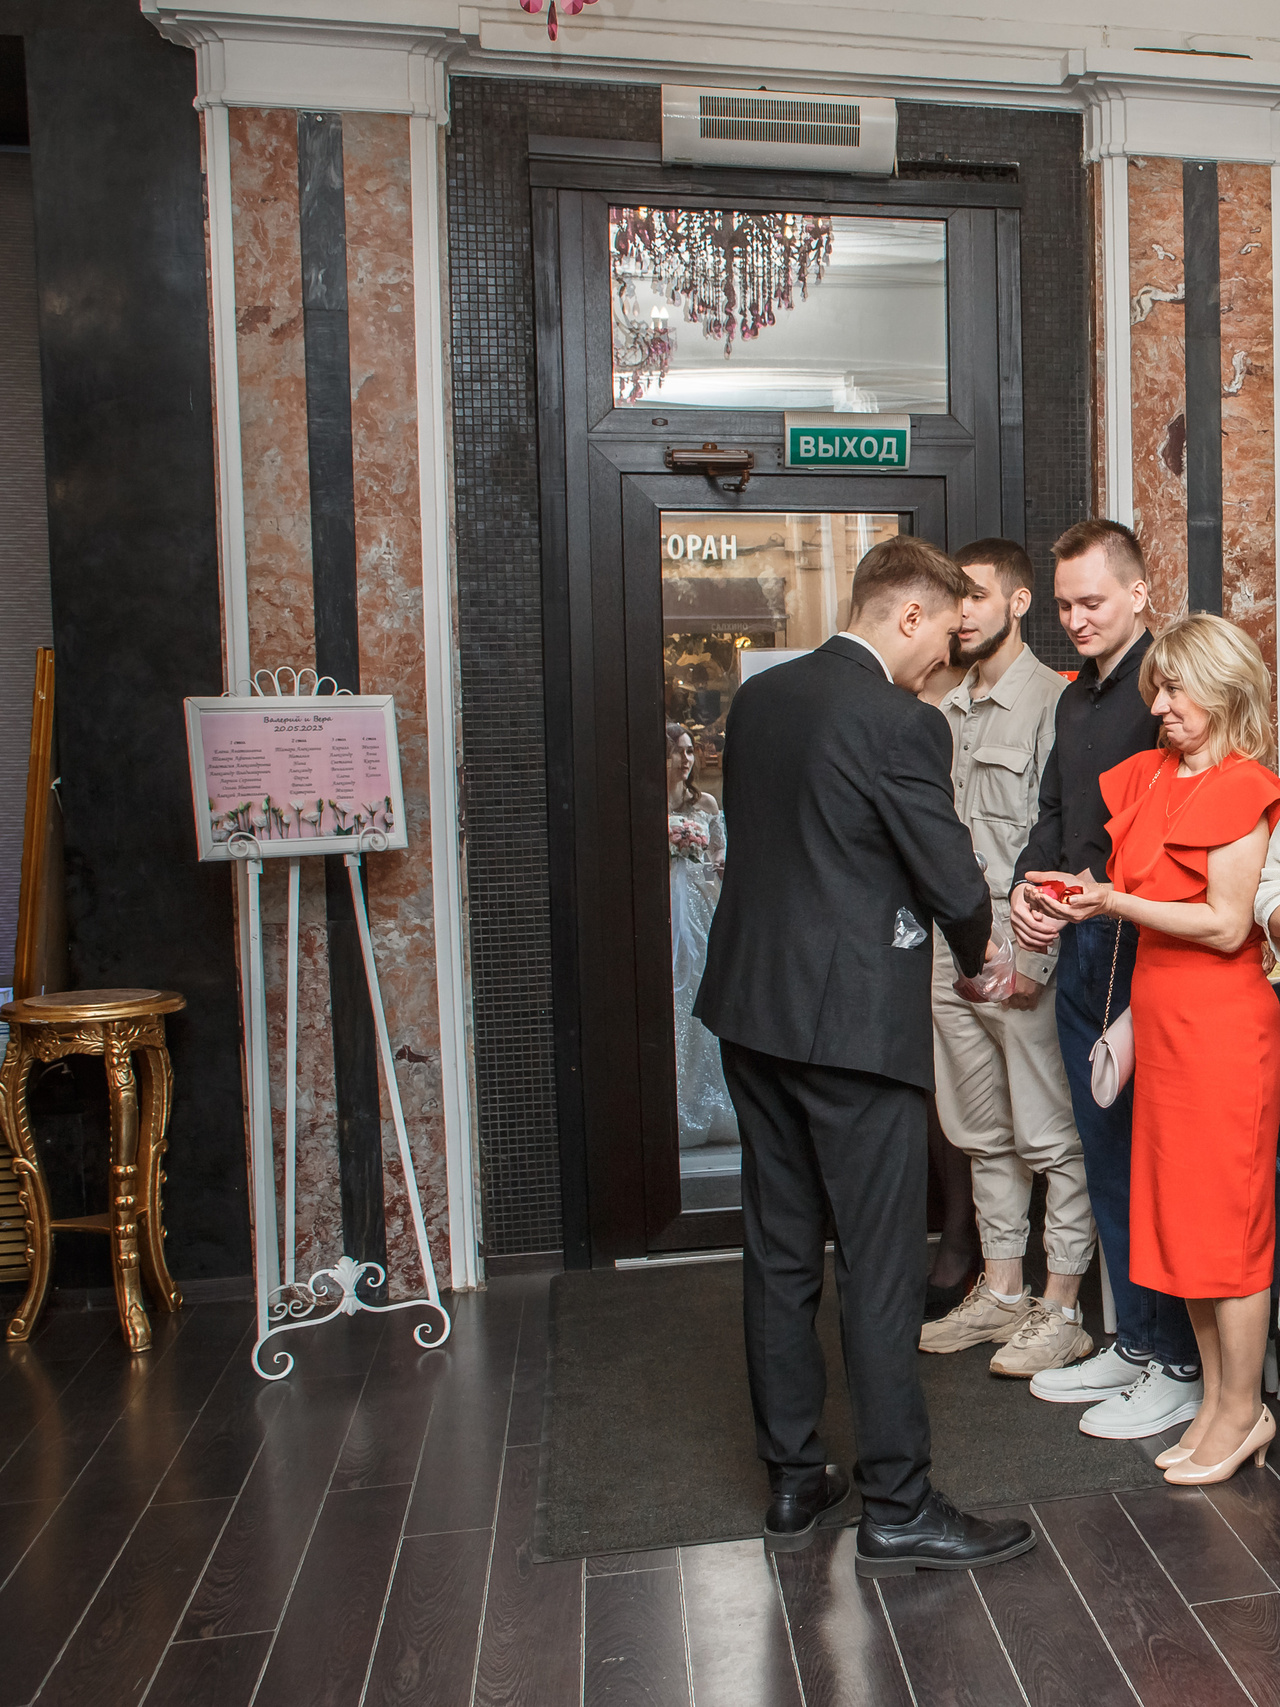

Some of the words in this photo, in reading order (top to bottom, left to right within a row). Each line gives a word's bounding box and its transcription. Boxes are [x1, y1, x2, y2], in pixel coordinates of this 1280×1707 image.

[799, 436, 898, 462] ВЫХОД
[661, 534, 737, 560] ОРАН
[263, 715, 302, 724] Валерий
[313, 715, 333, 723] Вера
